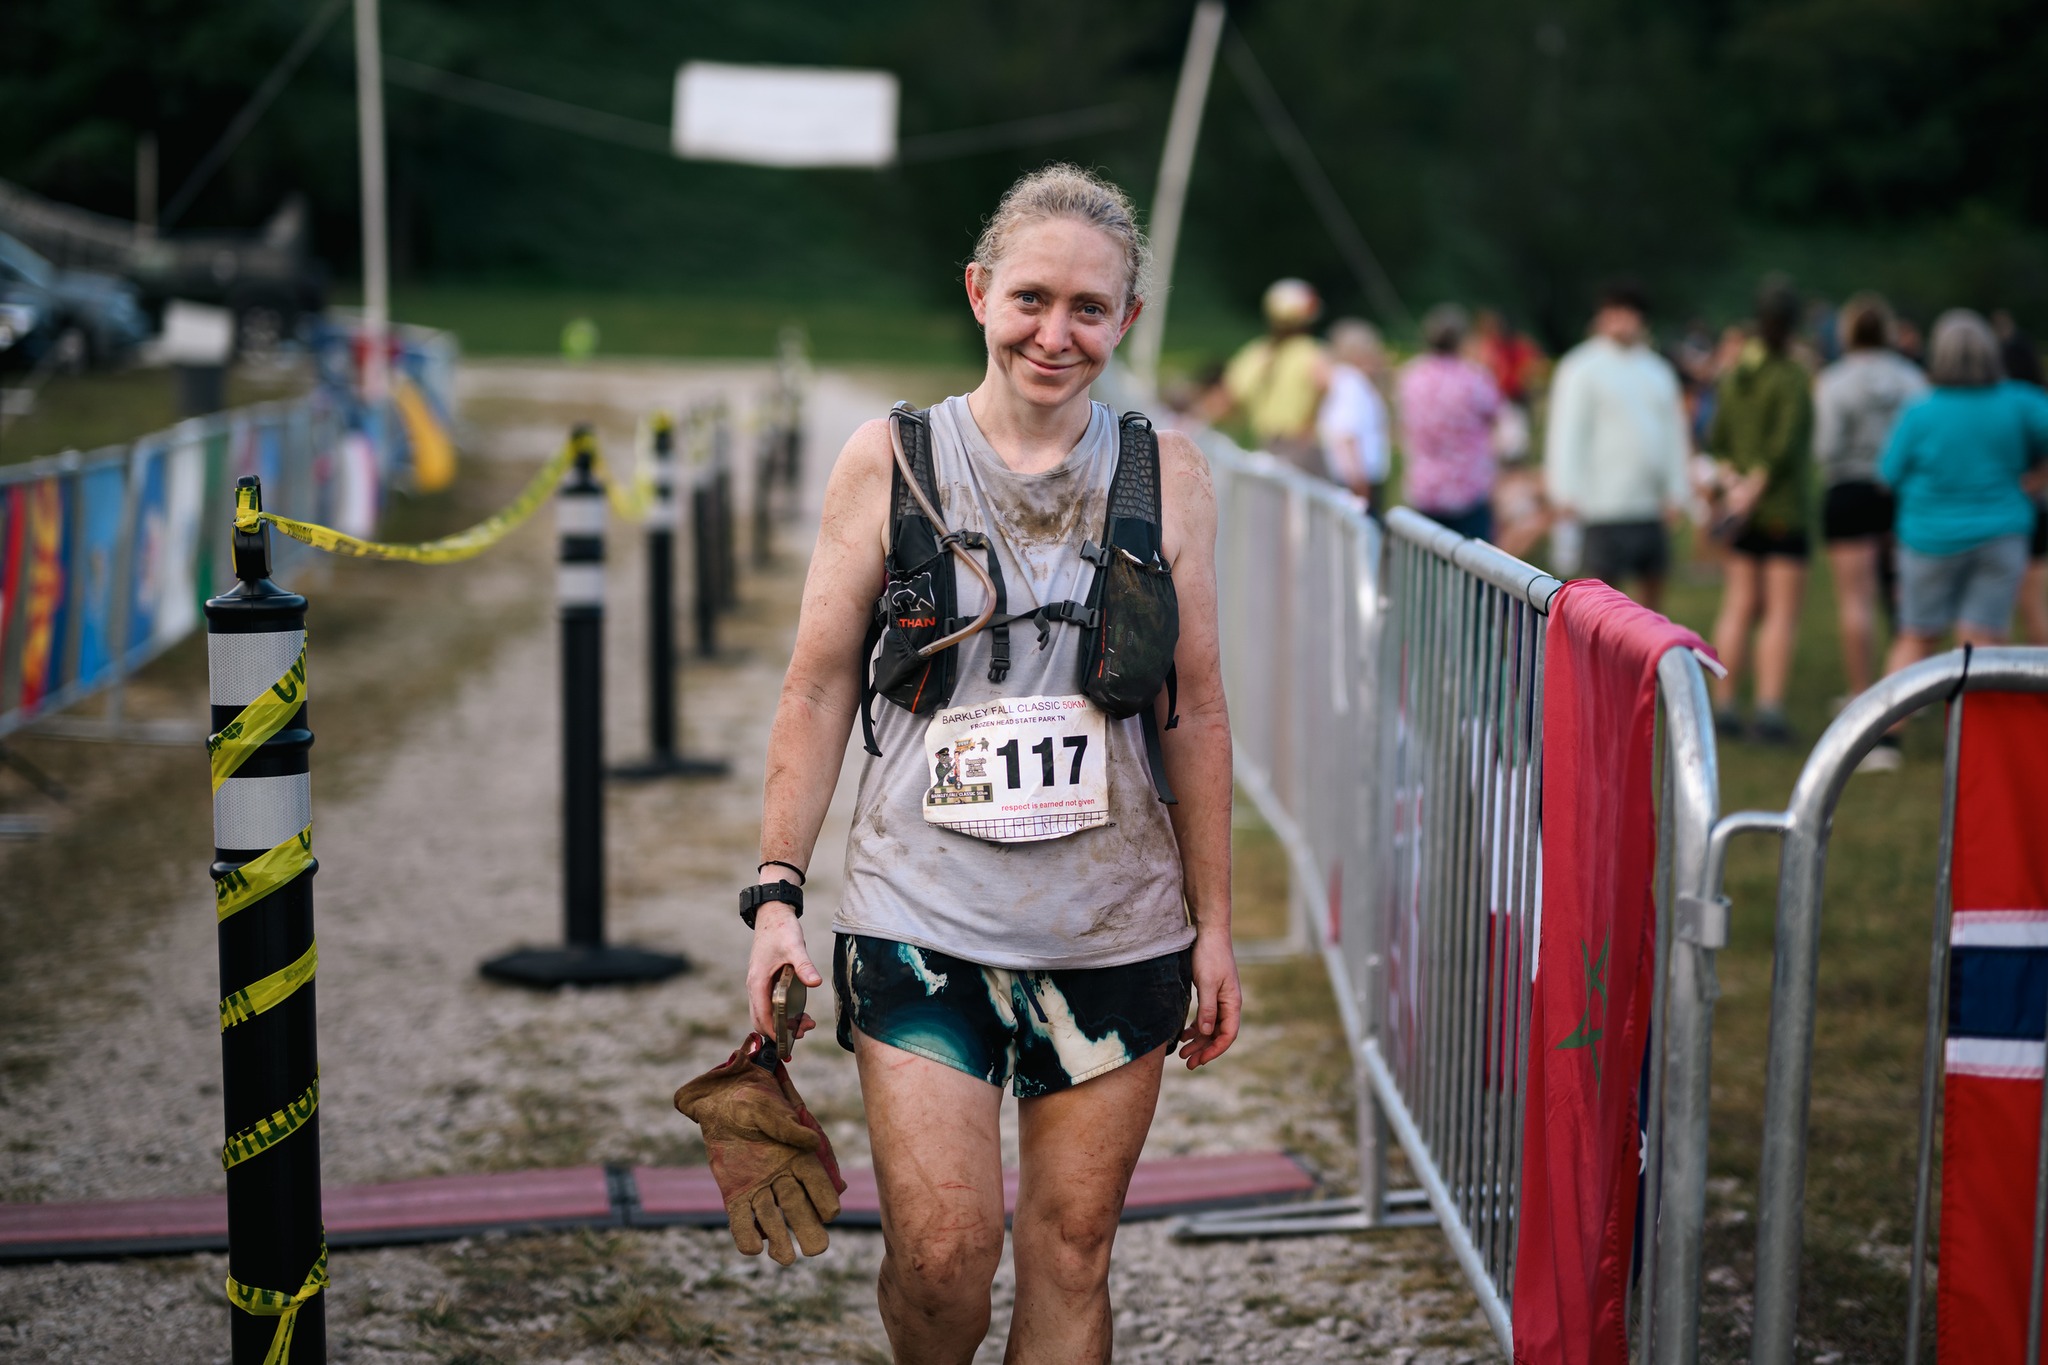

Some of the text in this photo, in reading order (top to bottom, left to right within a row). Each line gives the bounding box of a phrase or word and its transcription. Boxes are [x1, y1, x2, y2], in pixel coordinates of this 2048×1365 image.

[898, 616, 936, 628] THAN
[942, 699, 1087, 725] BARKLEY FALL CLASSIC 50KM
[970, 714, 1066, 731] FROZEN HEAD STATE PARK TN
[996, 735, 1088, 790] 117
[1001, 798, 1095, 812] respect is earned not given
